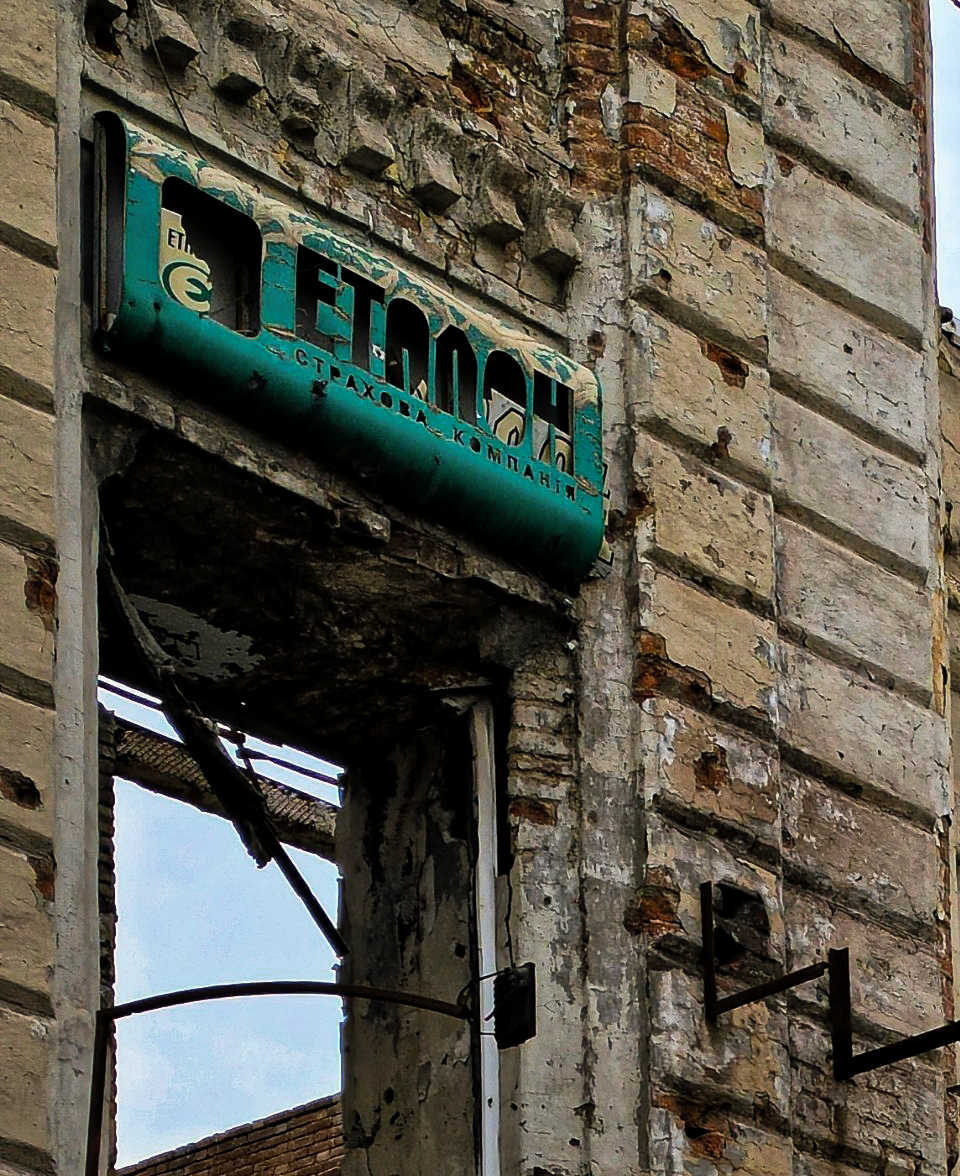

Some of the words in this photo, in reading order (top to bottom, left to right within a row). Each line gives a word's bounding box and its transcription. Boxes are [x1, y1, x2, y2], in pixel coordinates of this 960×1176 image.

[294, 243, 575, 476] ЕТАЛОН
[295, 348, 427, 425] СТРАХОВА
[452, 426, 576, 501] КОМПАНІЯ
